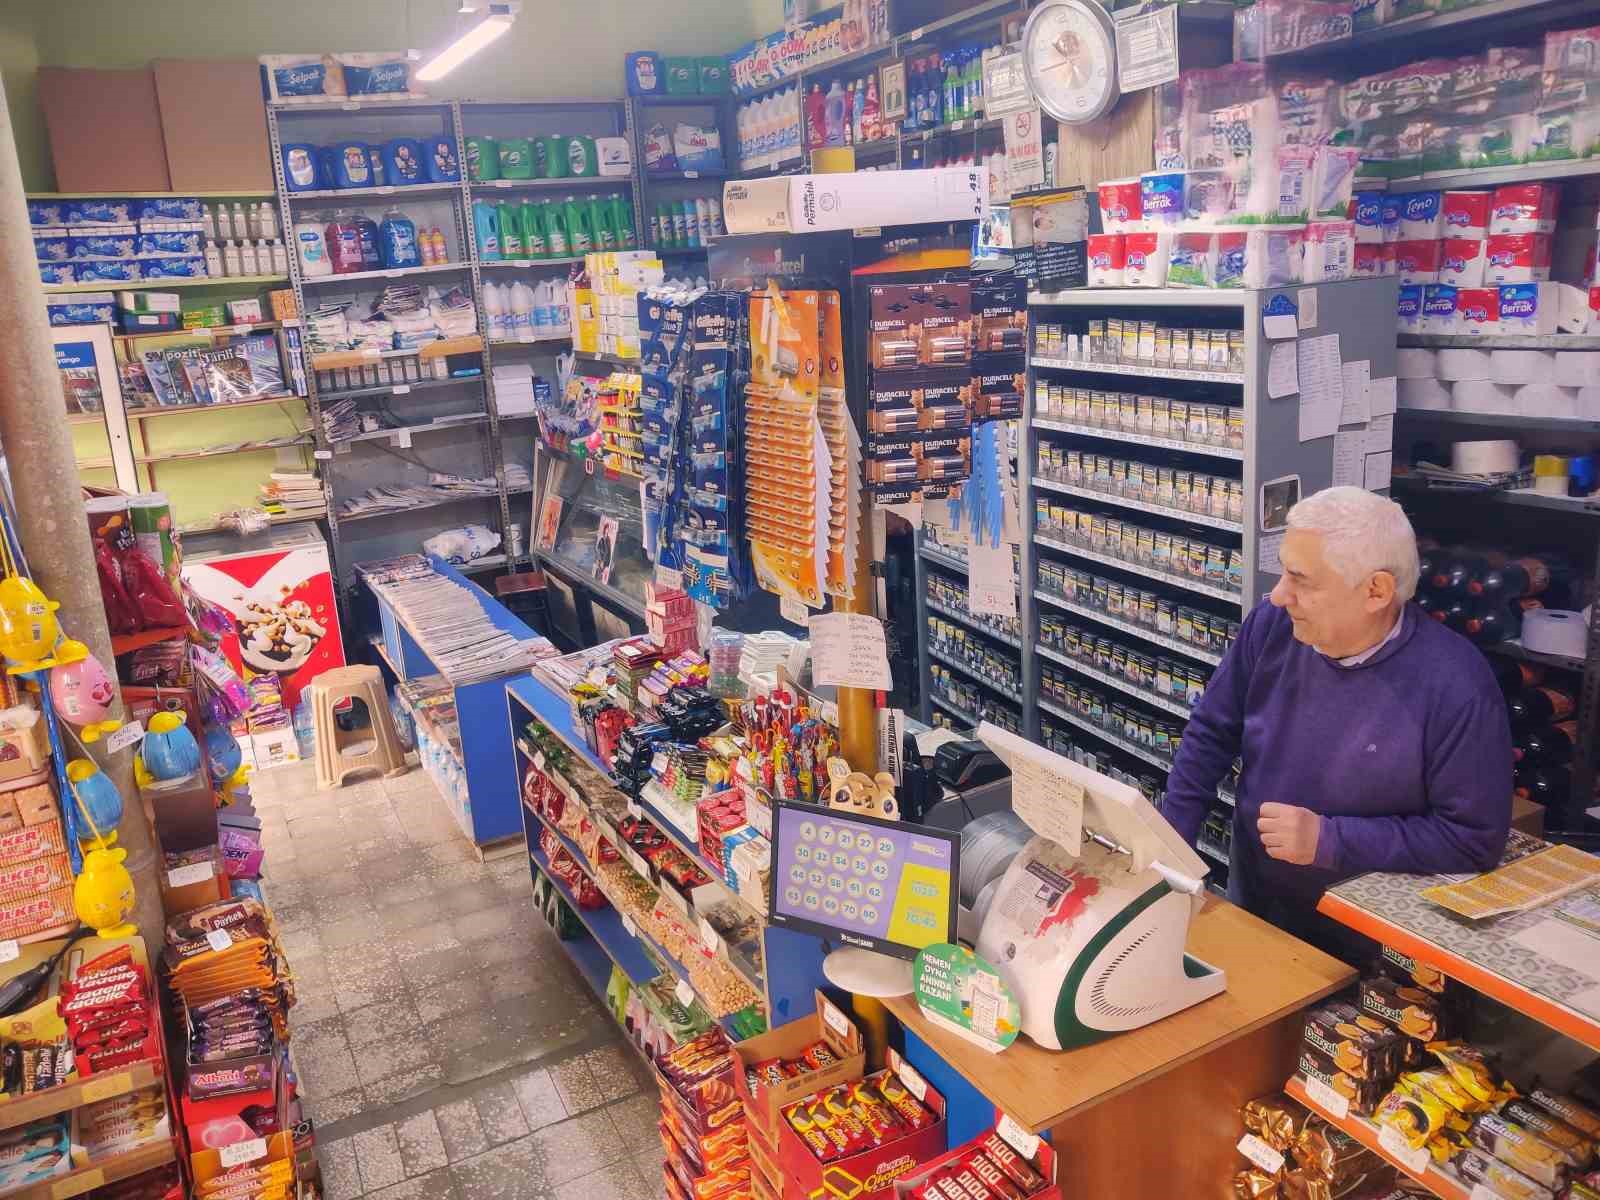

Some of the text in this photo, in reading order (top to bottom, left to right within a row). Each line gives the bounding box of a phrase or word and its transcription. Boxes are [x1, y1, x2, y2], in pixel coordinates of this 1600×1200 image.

[1426, 302, 1453, 313] Berrak
[1502, 303, 1533, 314] Berrak
[696, 314, 726, 328] Gillette
[876, 391, 910, 399] DURACELL
[925, 387, 957, 396] DURACELL
[925, 439, 957, 447] DURACELL
[877, 492, 909, 500] DURACELL
[1, 831, 36, 846] KER
[0, 864, 48, 883] LKER
[922, 952, 951, 970] HEMEN
[924, 964, 948, 980] OYNA
[920, 974, 952, 992] ANINDA
